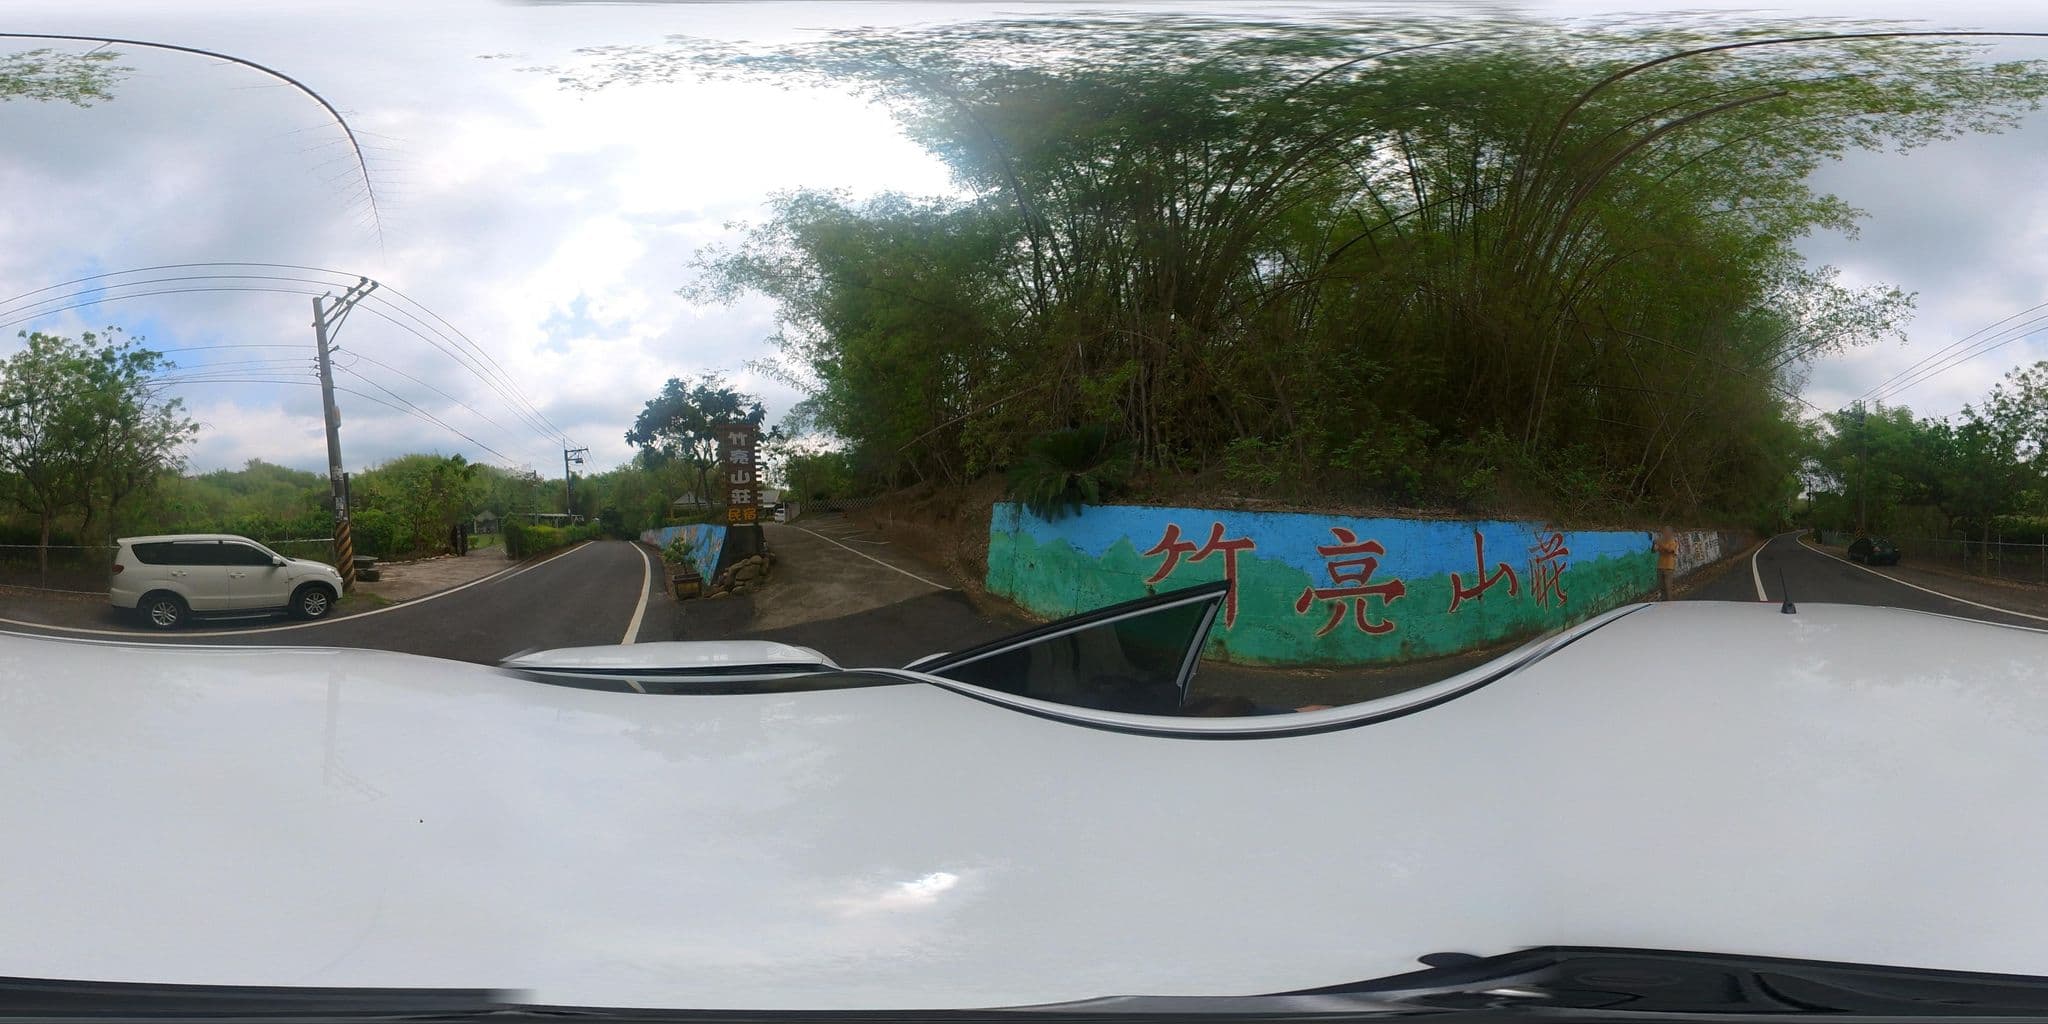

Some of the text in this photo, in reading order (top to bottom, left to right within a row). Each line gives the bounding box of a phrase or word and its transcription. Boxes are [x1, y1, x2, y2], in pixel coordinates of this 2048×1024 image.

[728, 431, 751, 504] 竹亮山莊
[729, 508, 756, 521] 民宿
